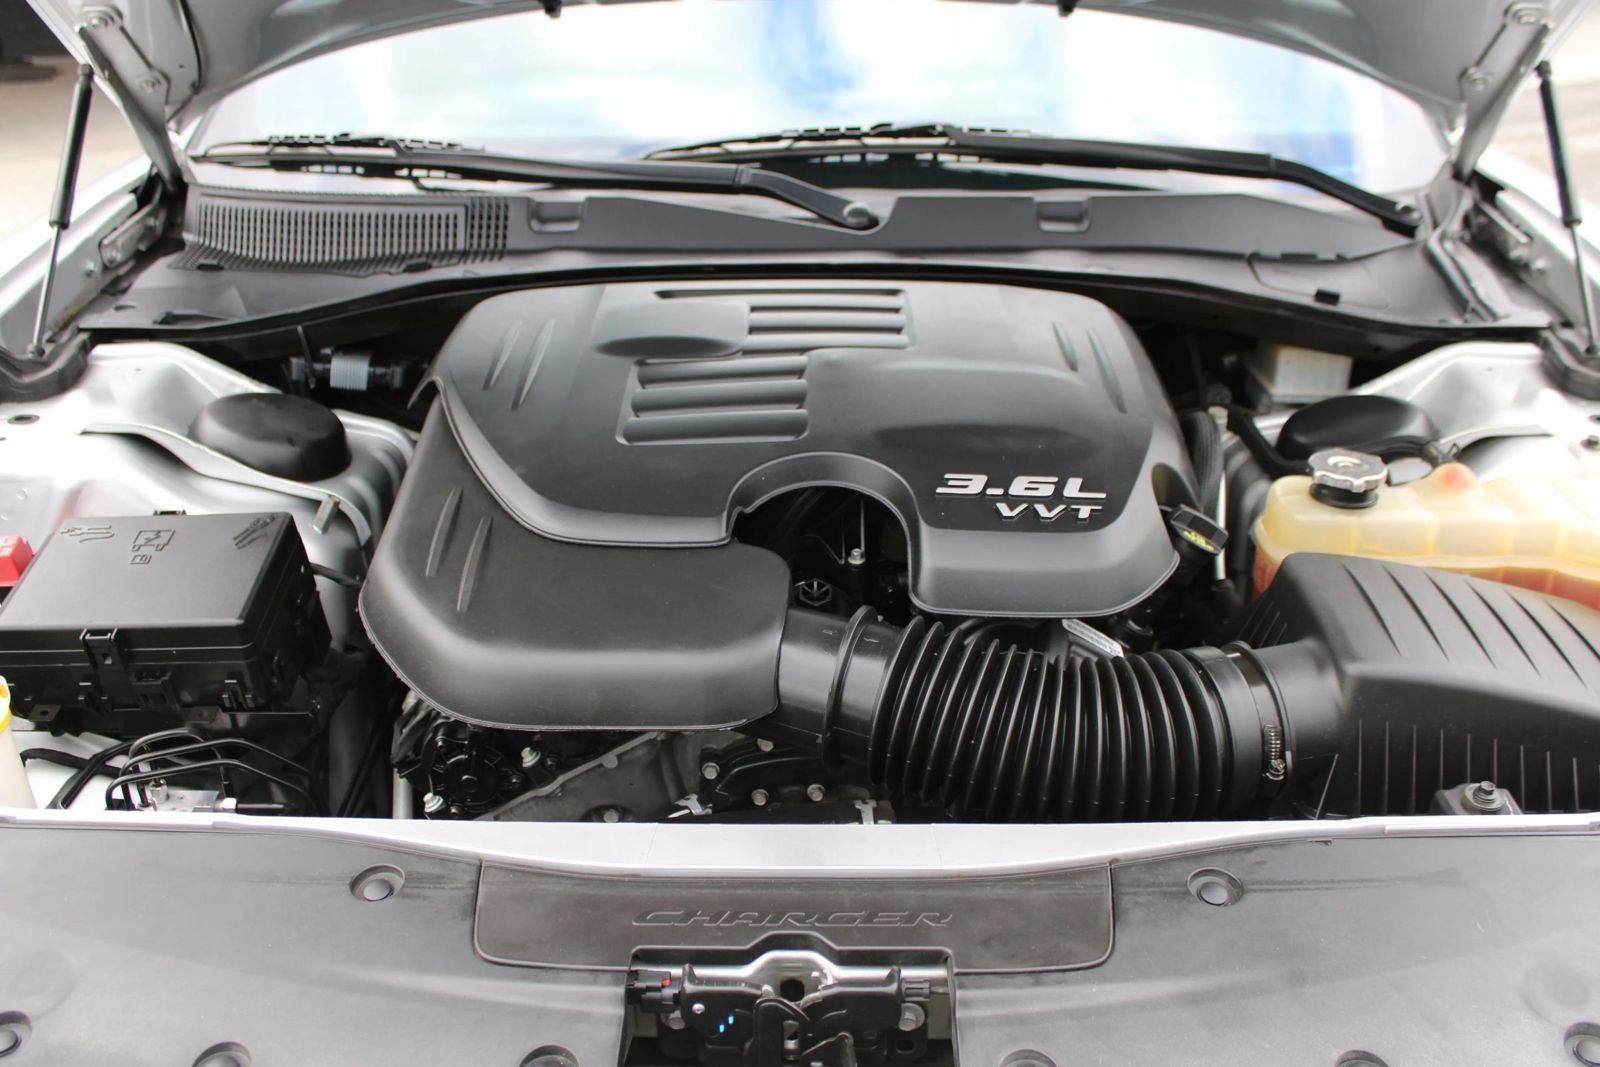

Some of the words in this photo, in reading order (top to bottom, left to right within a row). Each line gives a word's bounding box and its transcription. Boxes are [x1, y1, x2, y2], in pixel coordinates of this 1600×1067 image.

[935, 473, 1107, 499] 3.6L
[995, 502, 1103, 520] VVT
[631, 909, 953, 927] CHARGER
